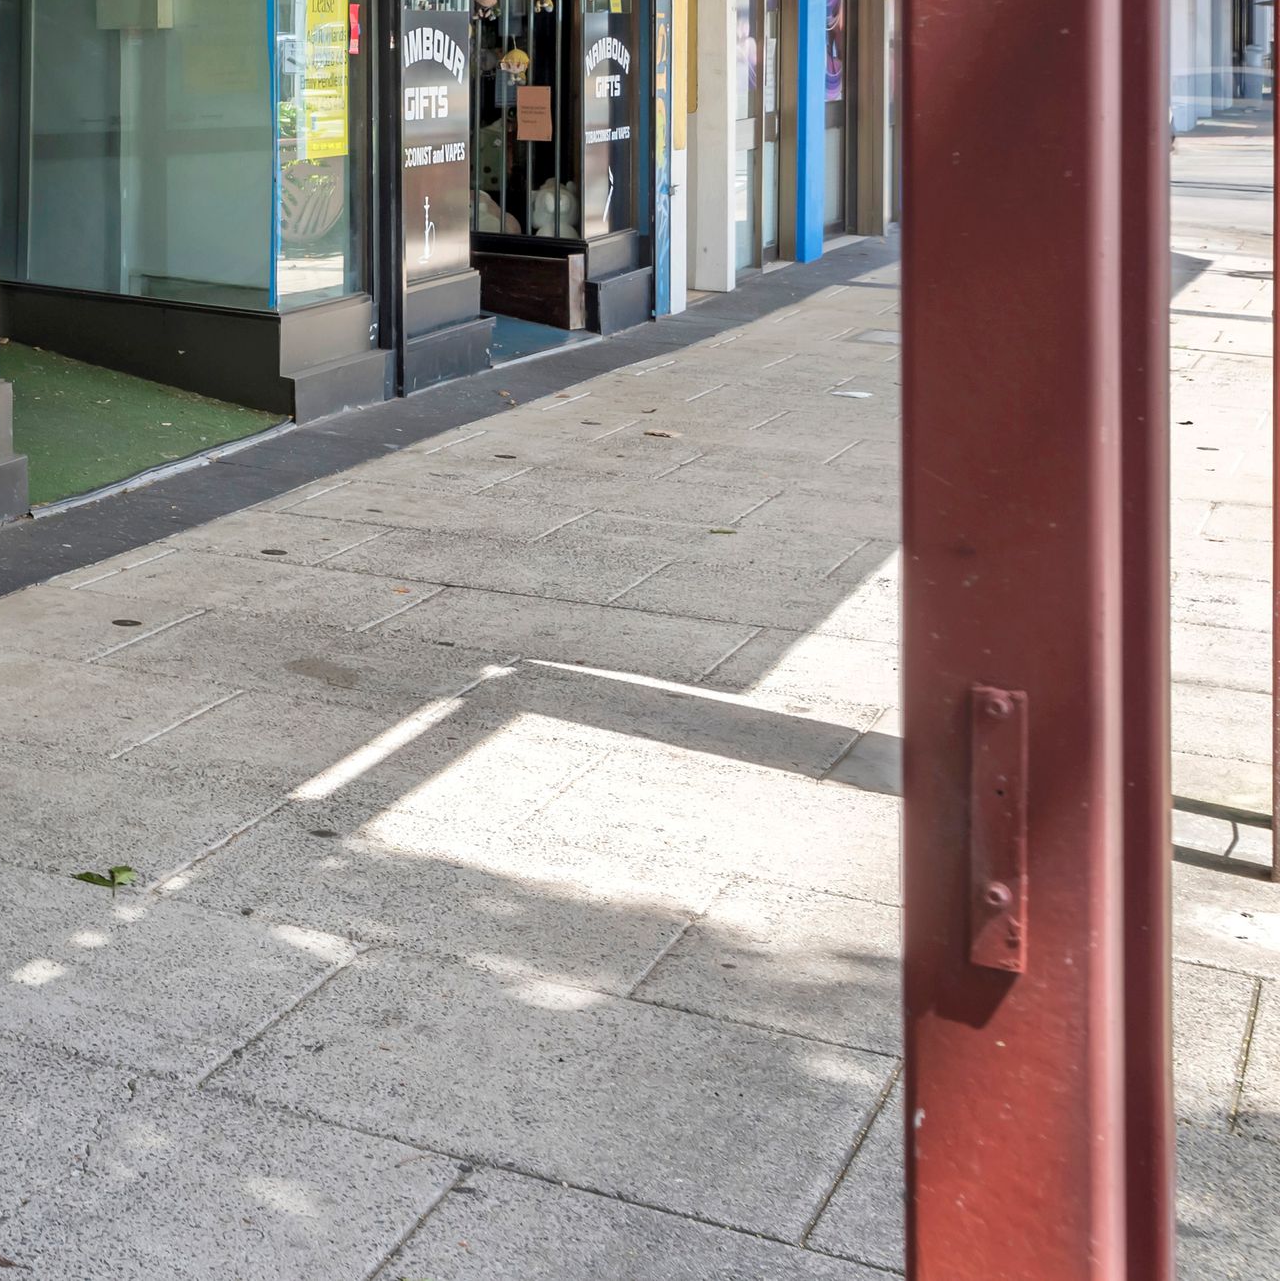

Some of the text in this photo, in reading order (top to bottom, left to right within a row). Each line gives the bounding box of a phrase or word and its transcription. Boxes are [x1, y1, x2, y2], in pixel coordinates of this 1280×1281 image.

[585, 37, 631, 77] NAMBOUR
[595, 74, 621, 98] GIFTS
[405, 86, 449, 120] GIFTS
[432, 147, 444, 164] and
[444, 142, 465, 162] VAPES
